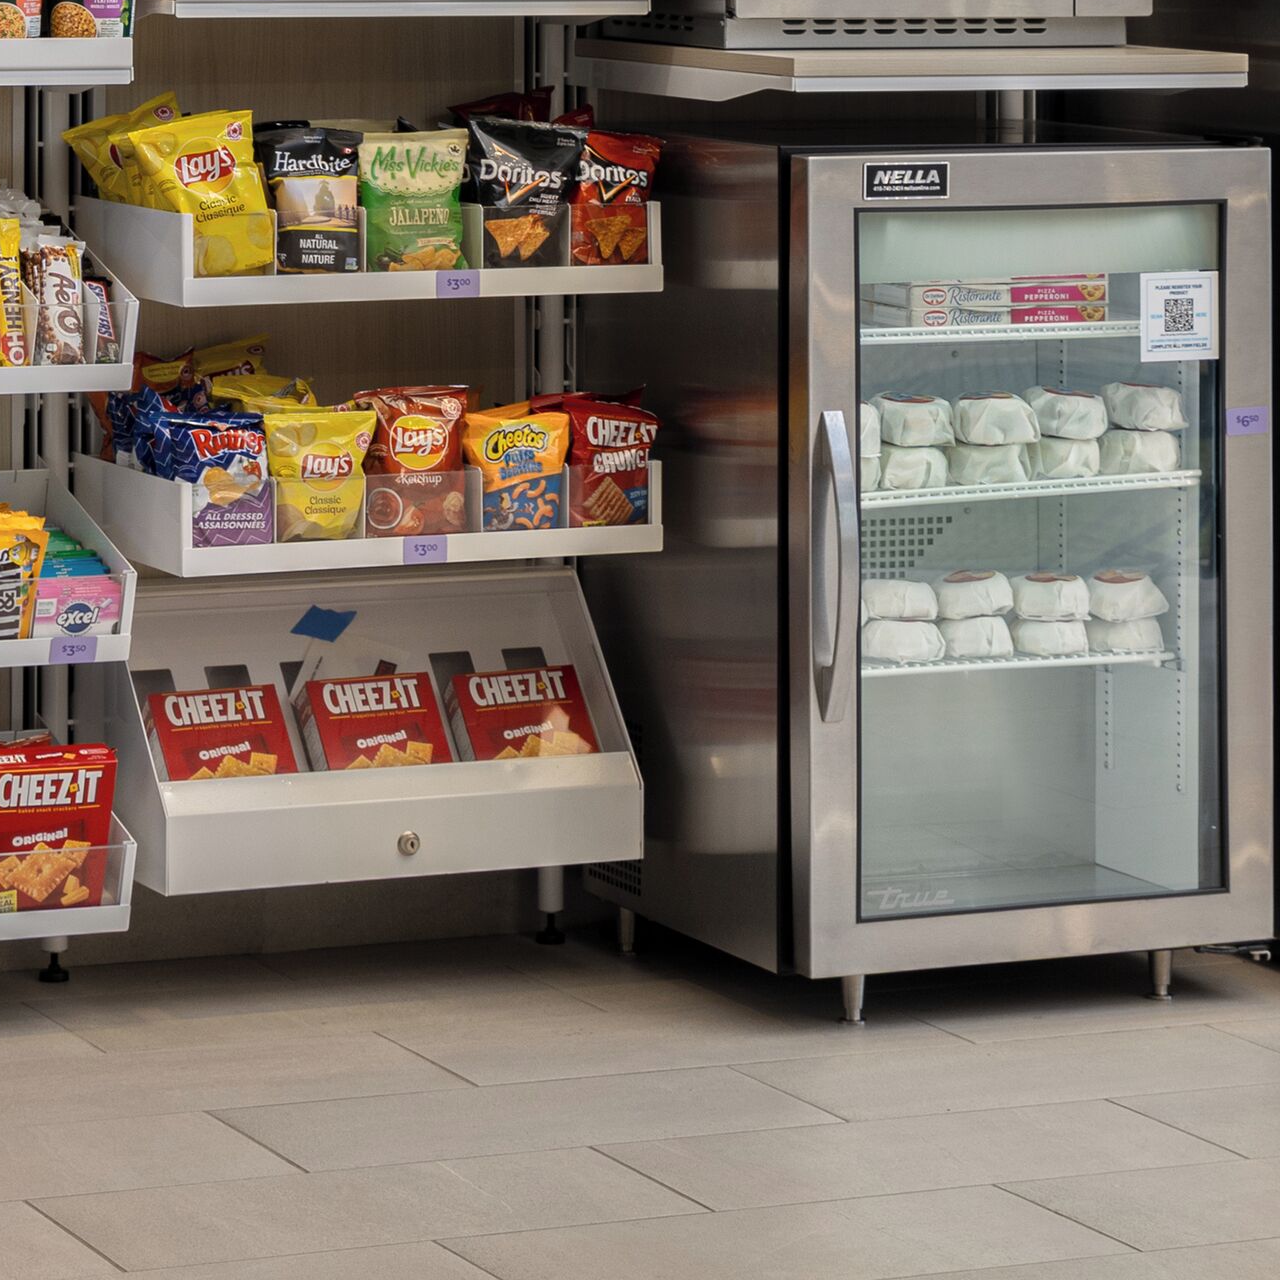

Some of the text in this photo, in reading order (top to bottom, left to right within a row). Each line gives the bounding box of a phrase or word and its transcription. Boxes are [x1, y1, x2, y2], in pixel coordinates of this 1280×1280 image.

[274, 151, 352, 173] Hardbite
[372, 145, 460, 183] Miss Vickie's
[480, 159, 562, 189] Doritos
[873, 169, 940, 185] NELLA
[390, 203, 450, 226] JALAPEÑO
[299, 239, 339, 250] NATURAL
[302, 254, 336, 265] NATURE
[948, 286, 1002, 305] Ristorante
[1024, 293, 1070, 301] PEPPERONI
[485, 425, 548, 462] Cheetos
[400, 473, 442, 486] Ketchup
[310, 496, 342, 505] Classic
[304, 505, 347, 515] Classique
[57, 607, 100, 629] excel
